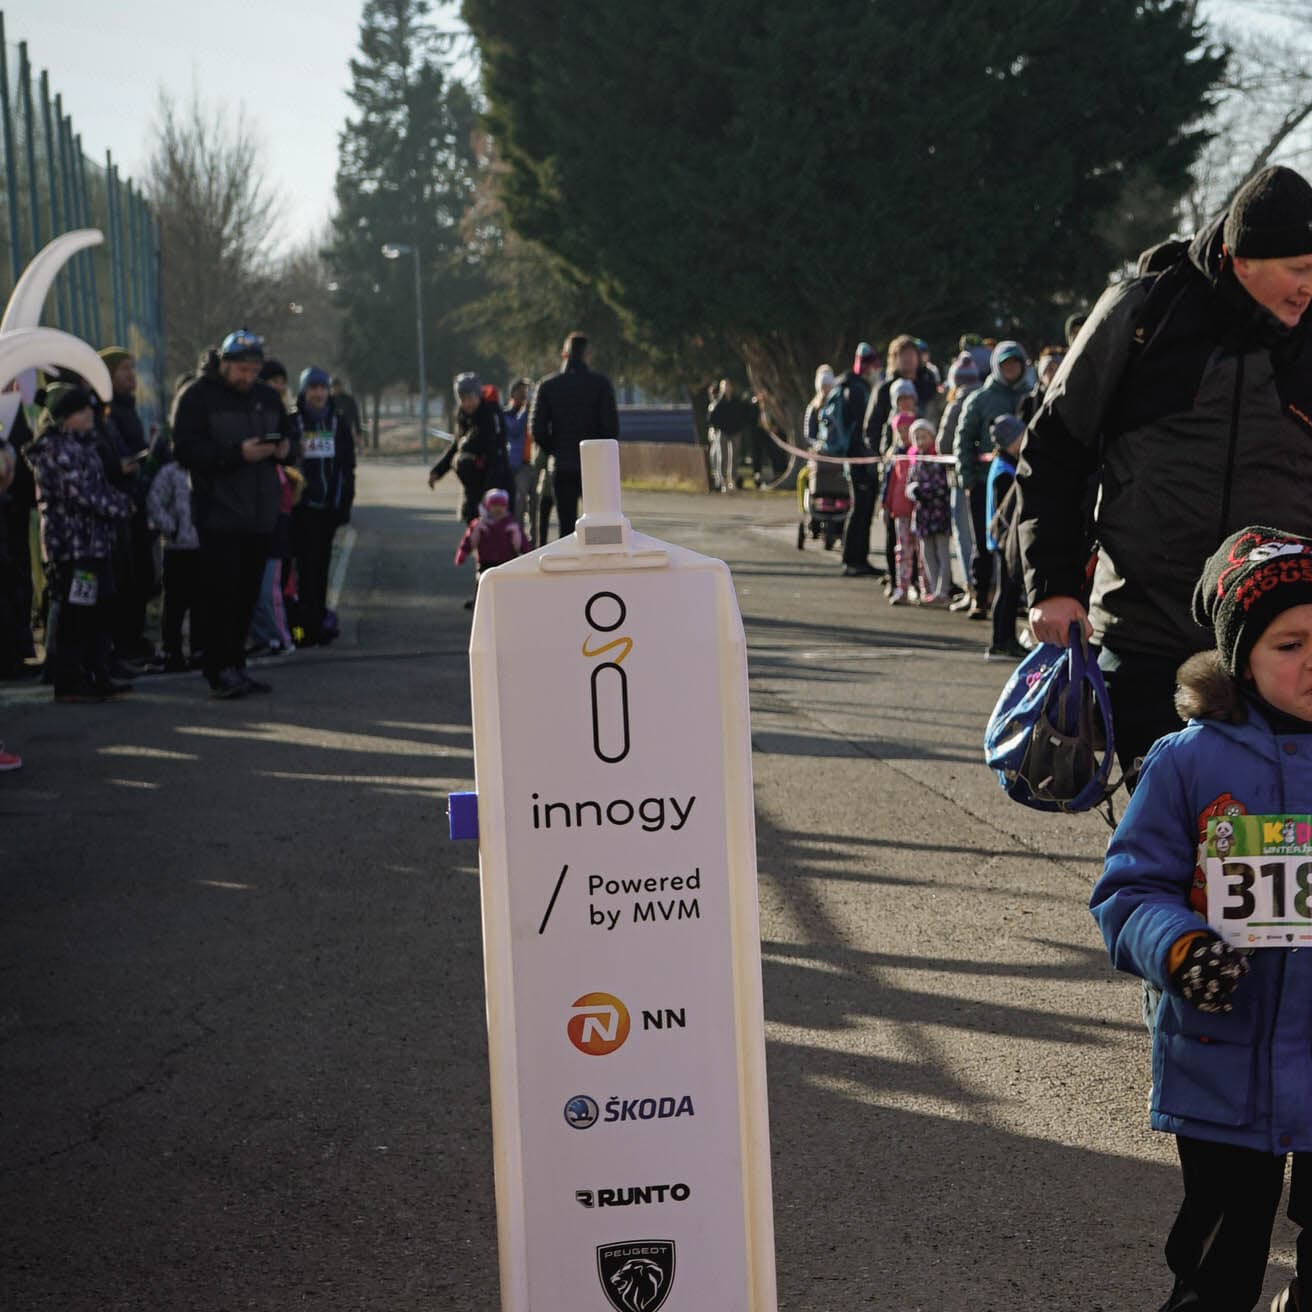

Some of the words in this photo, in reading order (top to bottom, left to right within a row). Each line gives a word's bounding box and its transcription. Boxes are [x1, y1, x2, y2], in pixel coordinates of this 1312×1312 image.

[532, 793, 696, 832] innogy
[588, 868, 701, 895] Powered
[589, 904, 621, 930] by
[633, 899, 701, 923] MVM
[642, 1008, 686, 1031] NN
[604, 1096, 695, 1122] ŠKODA
[598, 1183, 691, 1207] RUNTO
[604, 1246, 668, 1259] PEUGEOT
